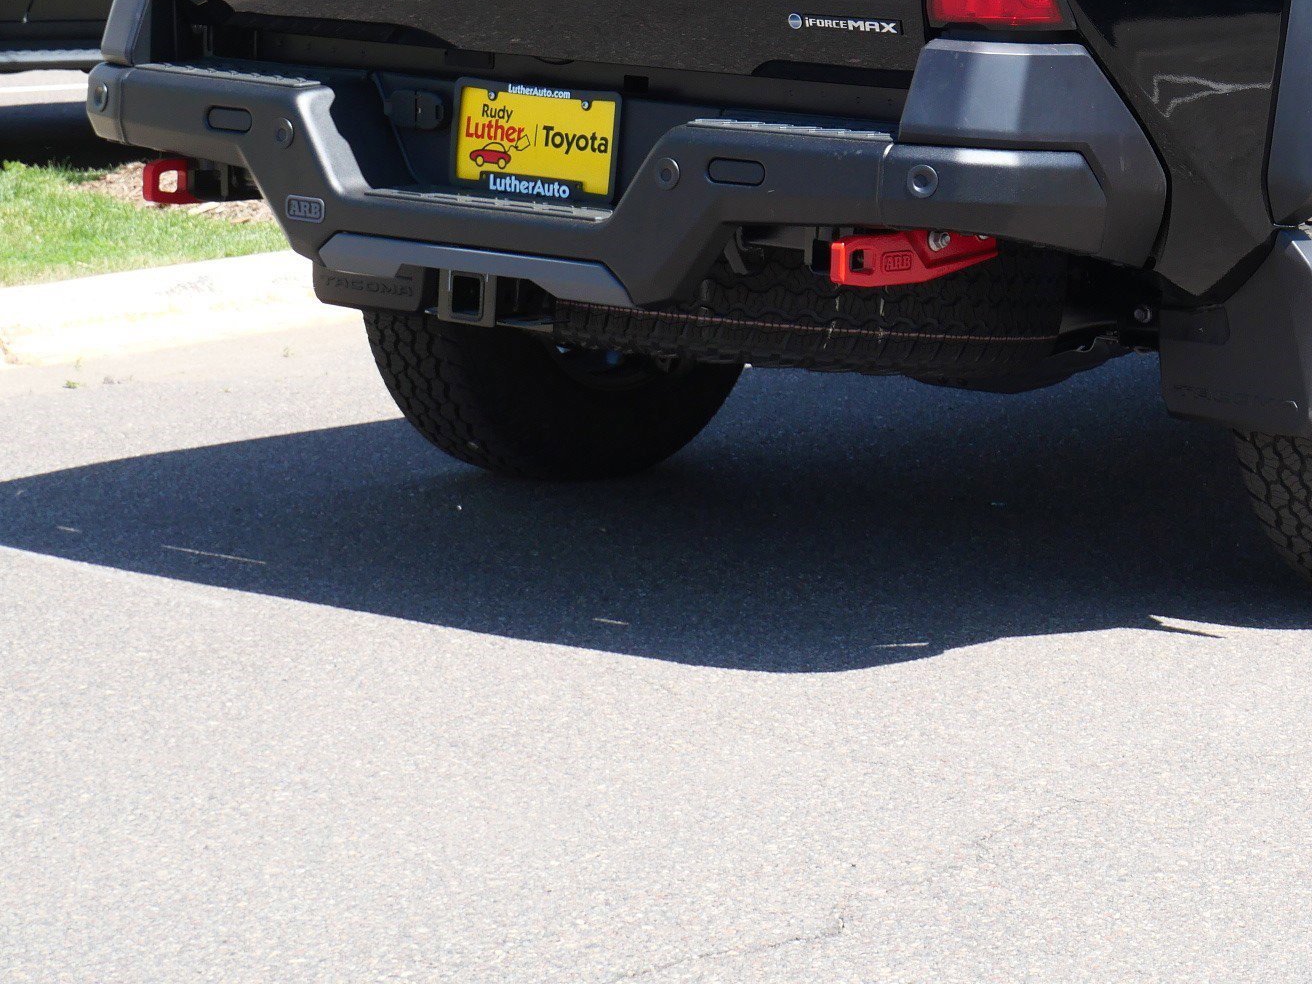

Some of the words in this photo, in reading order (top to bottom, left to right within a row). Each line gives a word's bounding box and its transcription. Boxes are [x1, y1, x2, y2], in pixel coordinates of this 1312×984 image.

[508, 83, 571, 99] LutherAuto.com
[482, 103, 513, 123] Rudy
[465, 116, 525, 143] Luther
[543, 124, 609, 155] Toyota
[489, 173, 570, 198] LutherAuto
[289, 199, 322, 220] ARB
[886, 254, 911, 271] ARB
[325, 275, 414, 298] TACOMA
